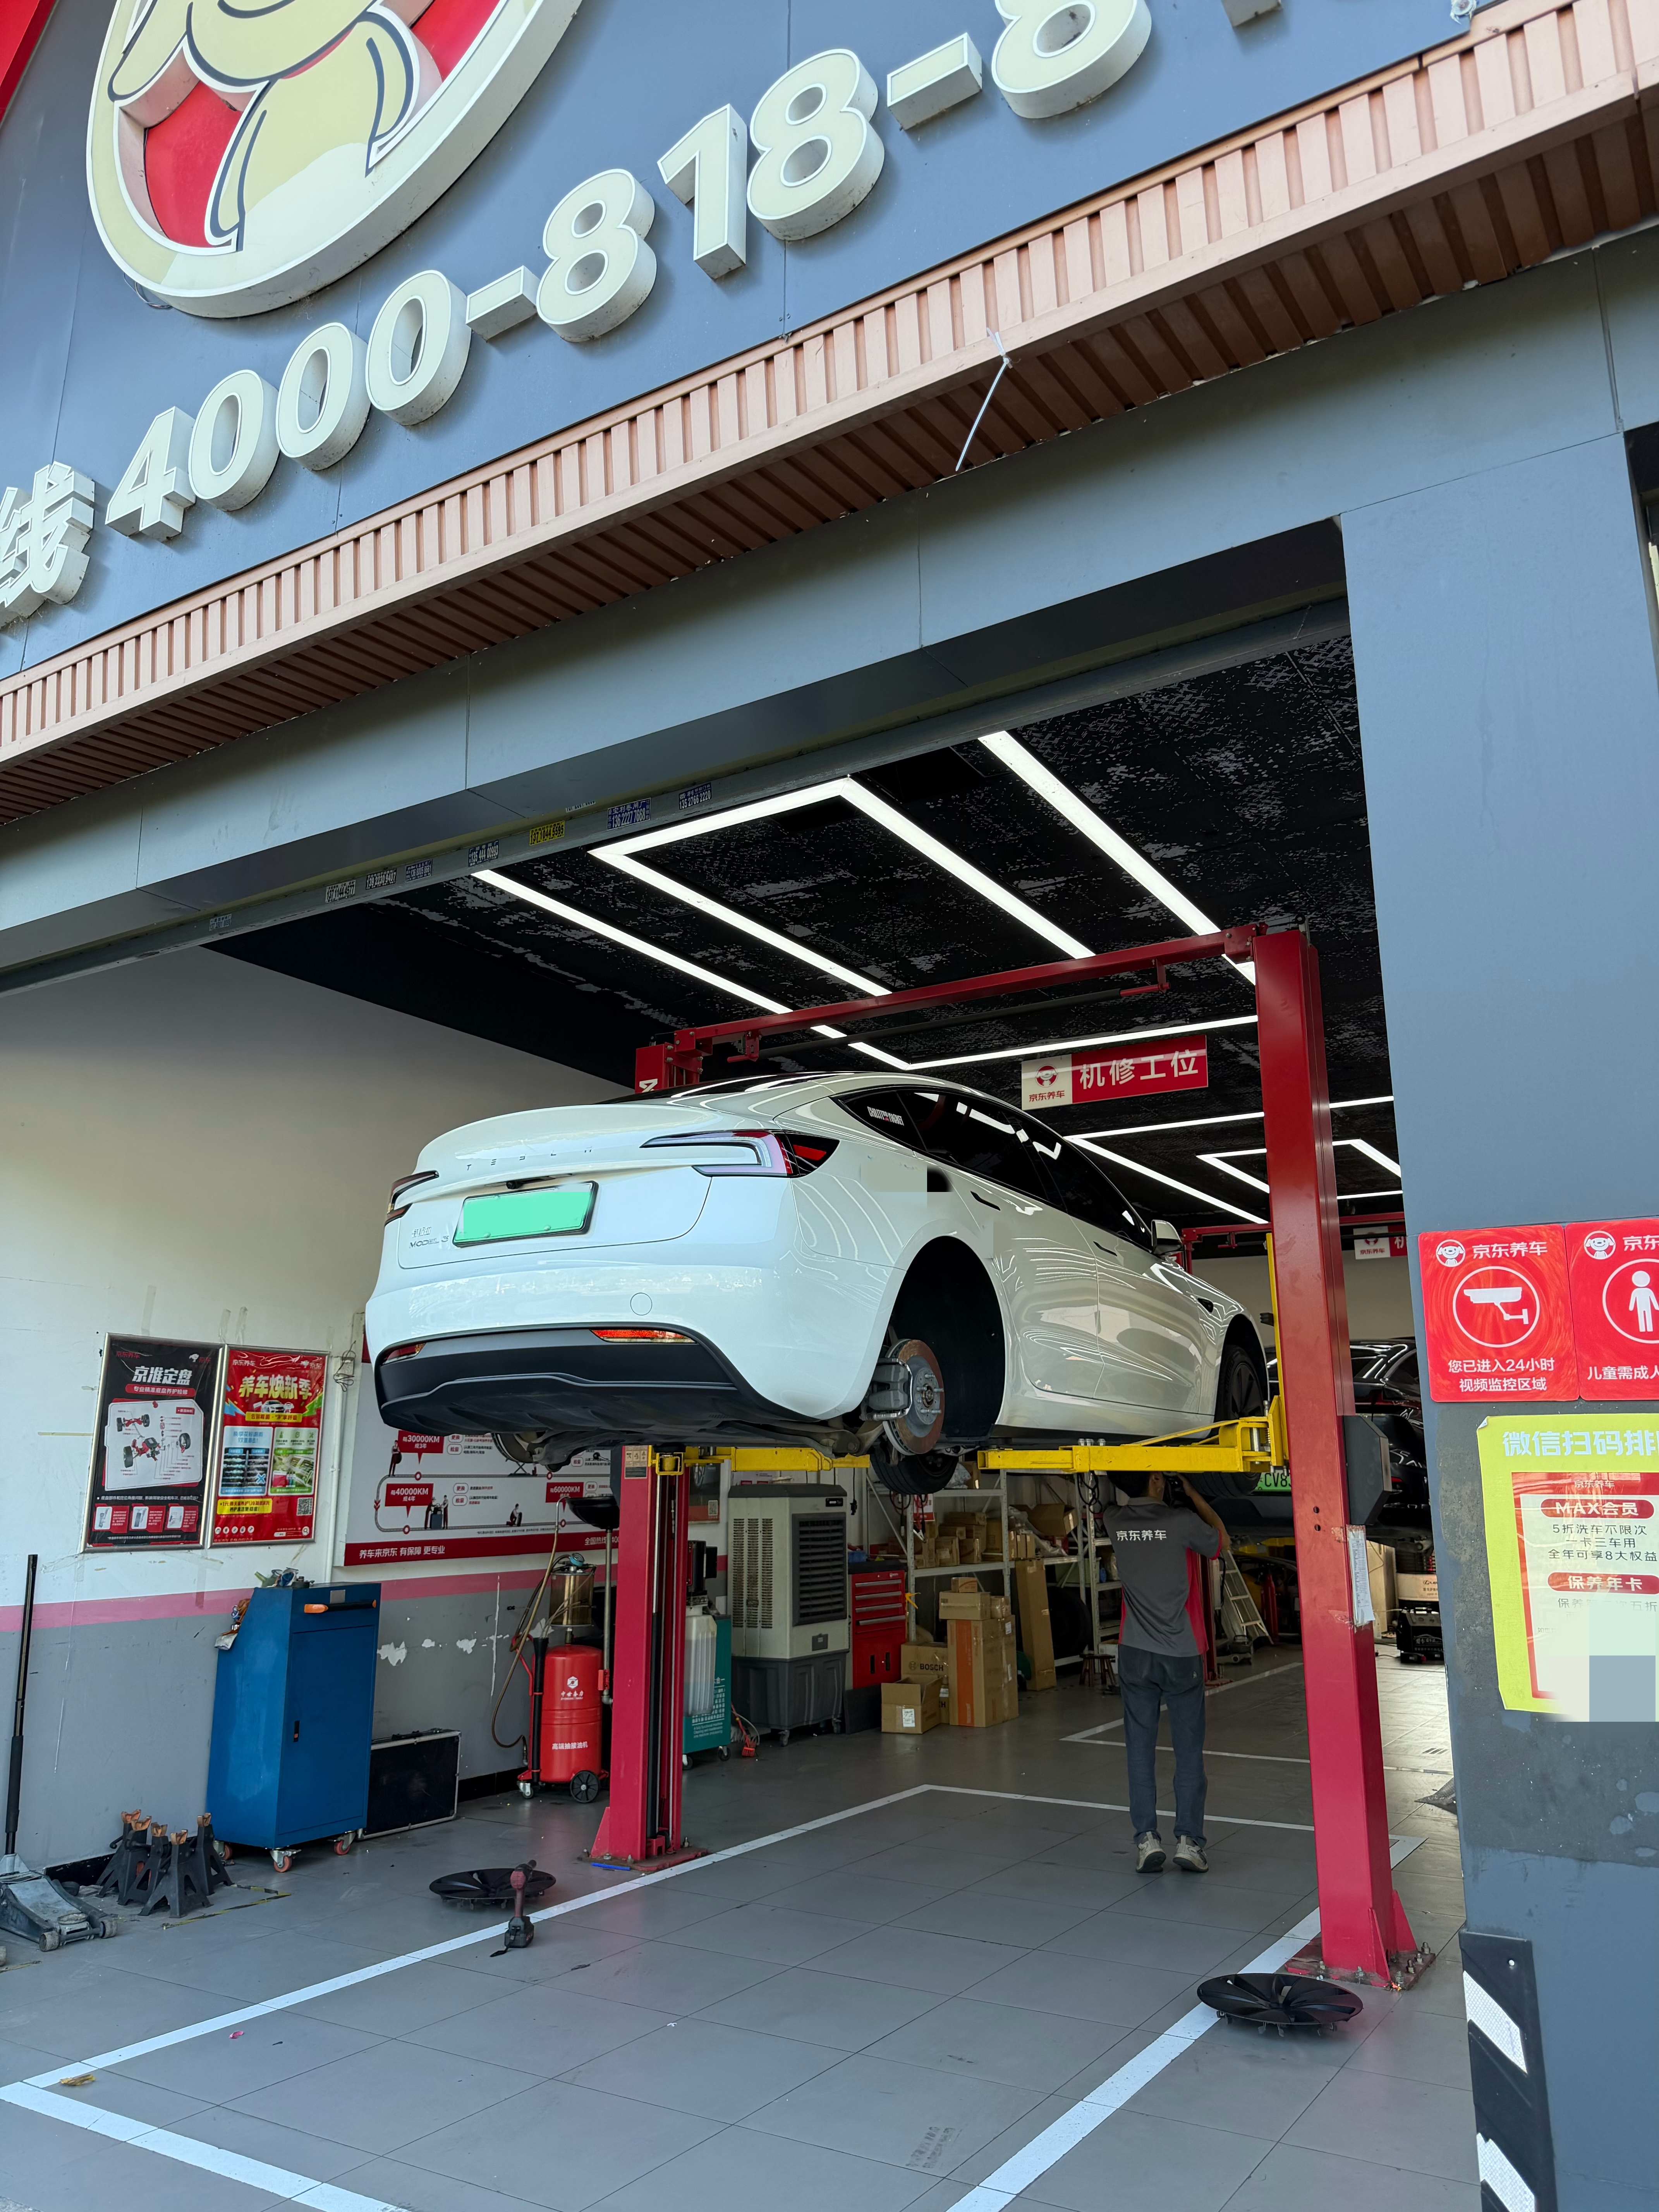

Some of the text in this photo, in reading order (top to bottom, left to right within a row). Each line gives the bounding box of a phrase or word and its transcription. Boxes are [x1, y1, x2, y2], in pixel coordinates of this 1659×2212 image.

[105, 0, 1282, 540] 4000-818-8
[688, 794, 699, 807] 2766
[700, 790, 711, 802] 2220
[612, 807, 646, 828] 136 2227 7668
[531, 832, 539, 843] 137
[540, 828, 551, 839] 1044
[1079, 1049, 1199, 1090] 机修工位
[1029, 1090, 1065, 1103] 京东养车
[1472, 1241, 1548, 1259] 京东养车
[1623, 1235, 1659, 1251] 京东
[1448, 1358, 1555, 1373] 您已进入24小时
[132, 1365, 192, 1385] 京准定盘
[239, 1374, 312, 1400] 养车焕新季
[1459, 1377, 1547, 1392] 视频监控区域
[403, 1434, 440, 1443] 每30000KM
[1502, 1430, 1659, 1456] 微信扫码排
[1265, 1473, 1291, 1487] CV8
[1574, 1480, 1615, 1488] 京东养车
[391, 1487, 428, 1496] 每40000KM
[1555, 1502, 1639, 1516] MAX会员
[1116, 1530, 1167, 1541] 京东养车
[1553, 1524, 1647, 1535] 5折洗车不限次
[1566, 1538, 1636, 1548] 一卡三车用
[359, 1545, 445, 1559] 养车来京东 有保障 更专业
[1548, 1549, 1658, 1562] 全年可享8大权益
[1568, 1575, 1643, 1591] 保养年卡
[920, 1663, 944, 1671] BOSCH
